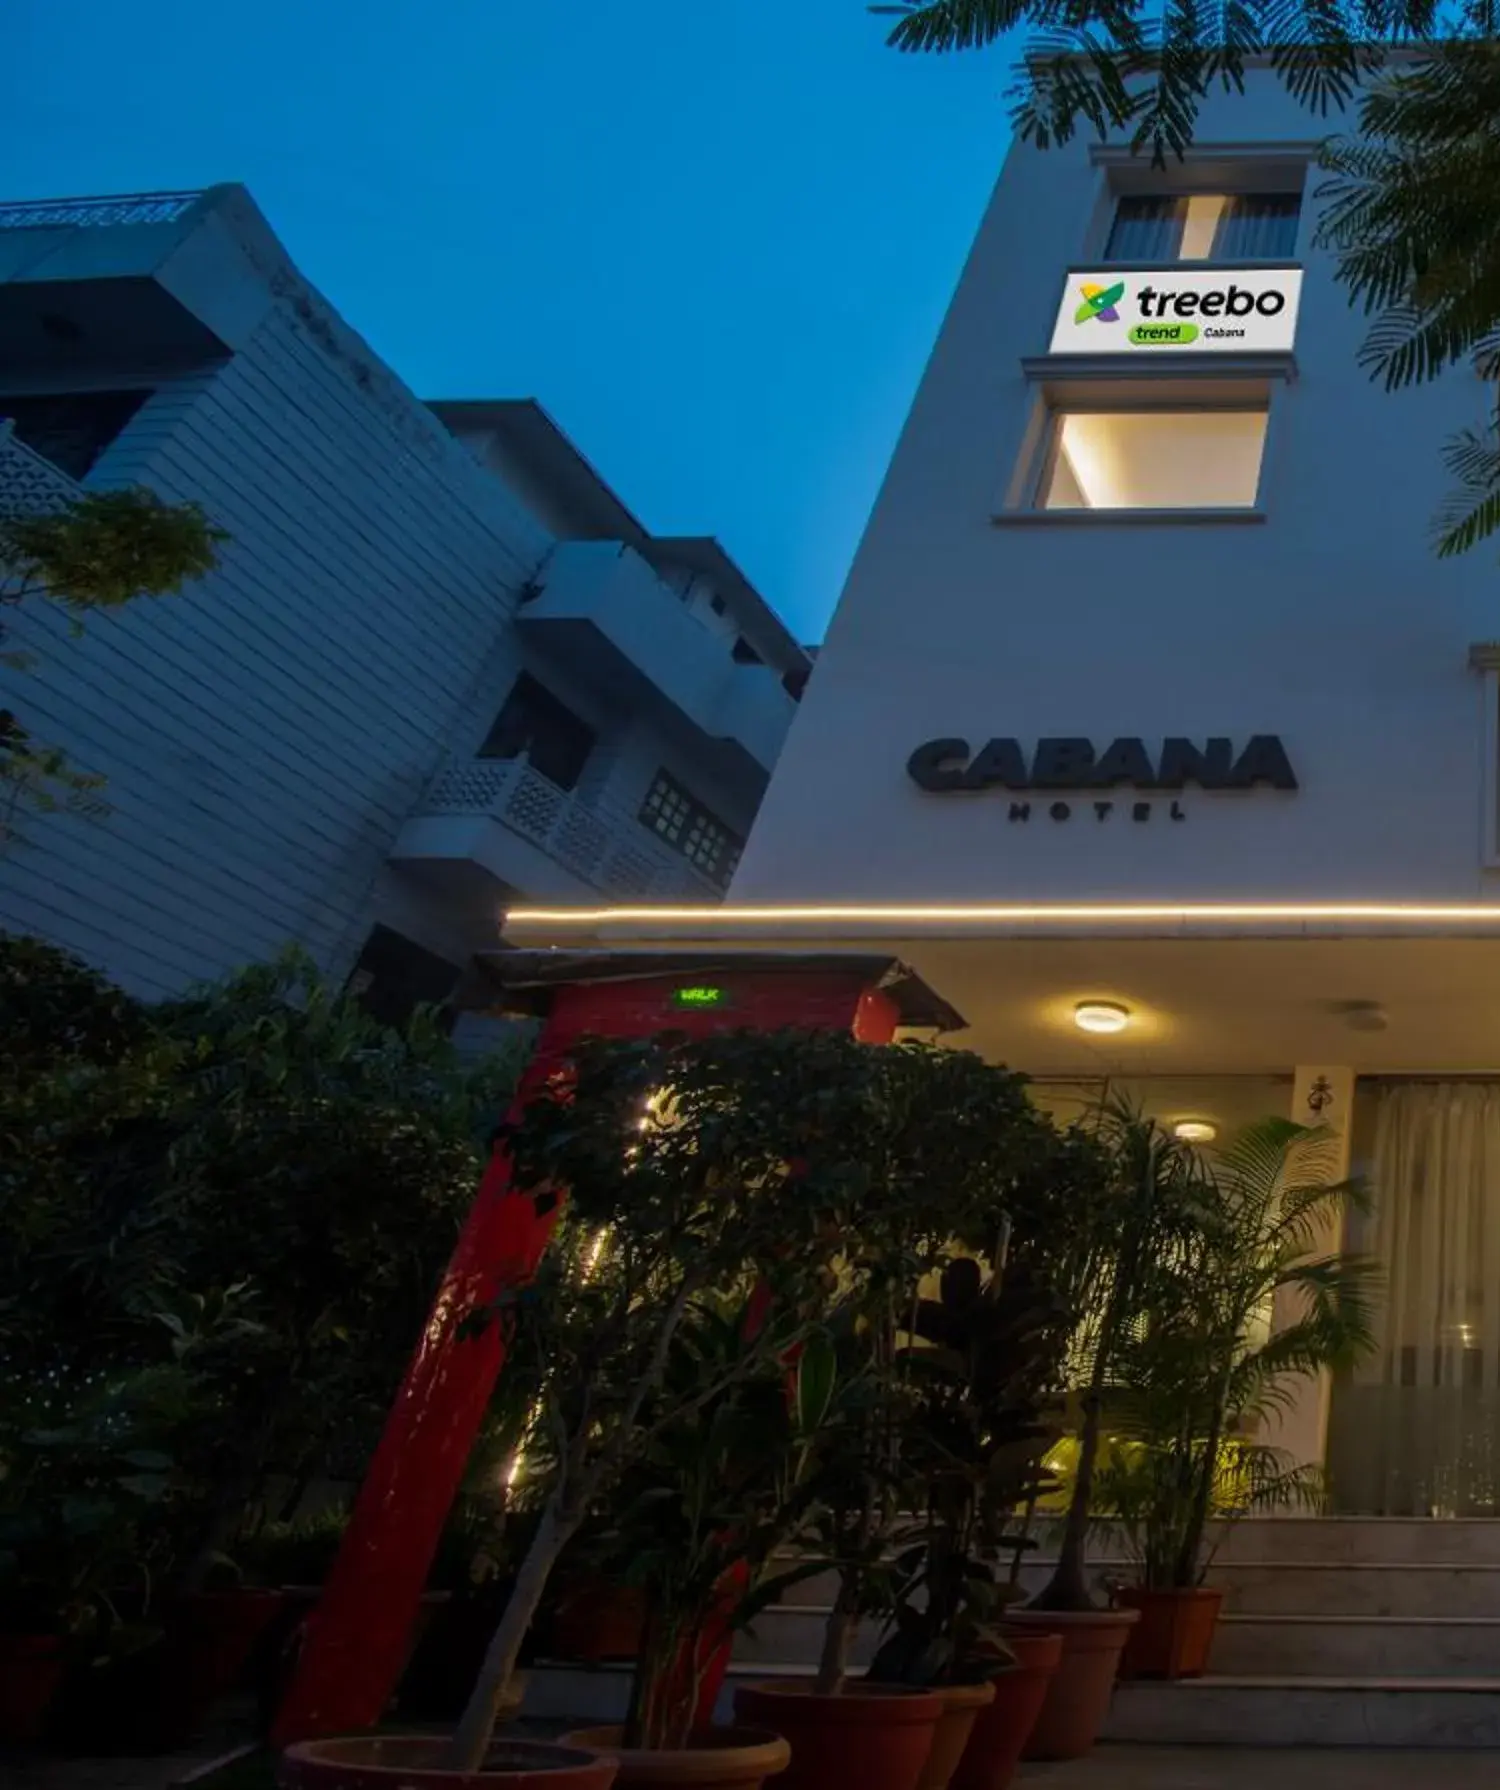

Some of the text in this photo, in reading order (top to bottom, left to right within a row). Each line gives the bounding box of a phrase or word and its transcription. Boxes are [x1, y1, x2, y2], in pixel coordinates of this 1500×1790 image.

[1136, 285, 1285, 317] treebo
[1136, 325, 1246, 339] trend Cabana
[906, 734, 1300, 791] CABANA
[1007, 801, 1187, 823] HOTEL
